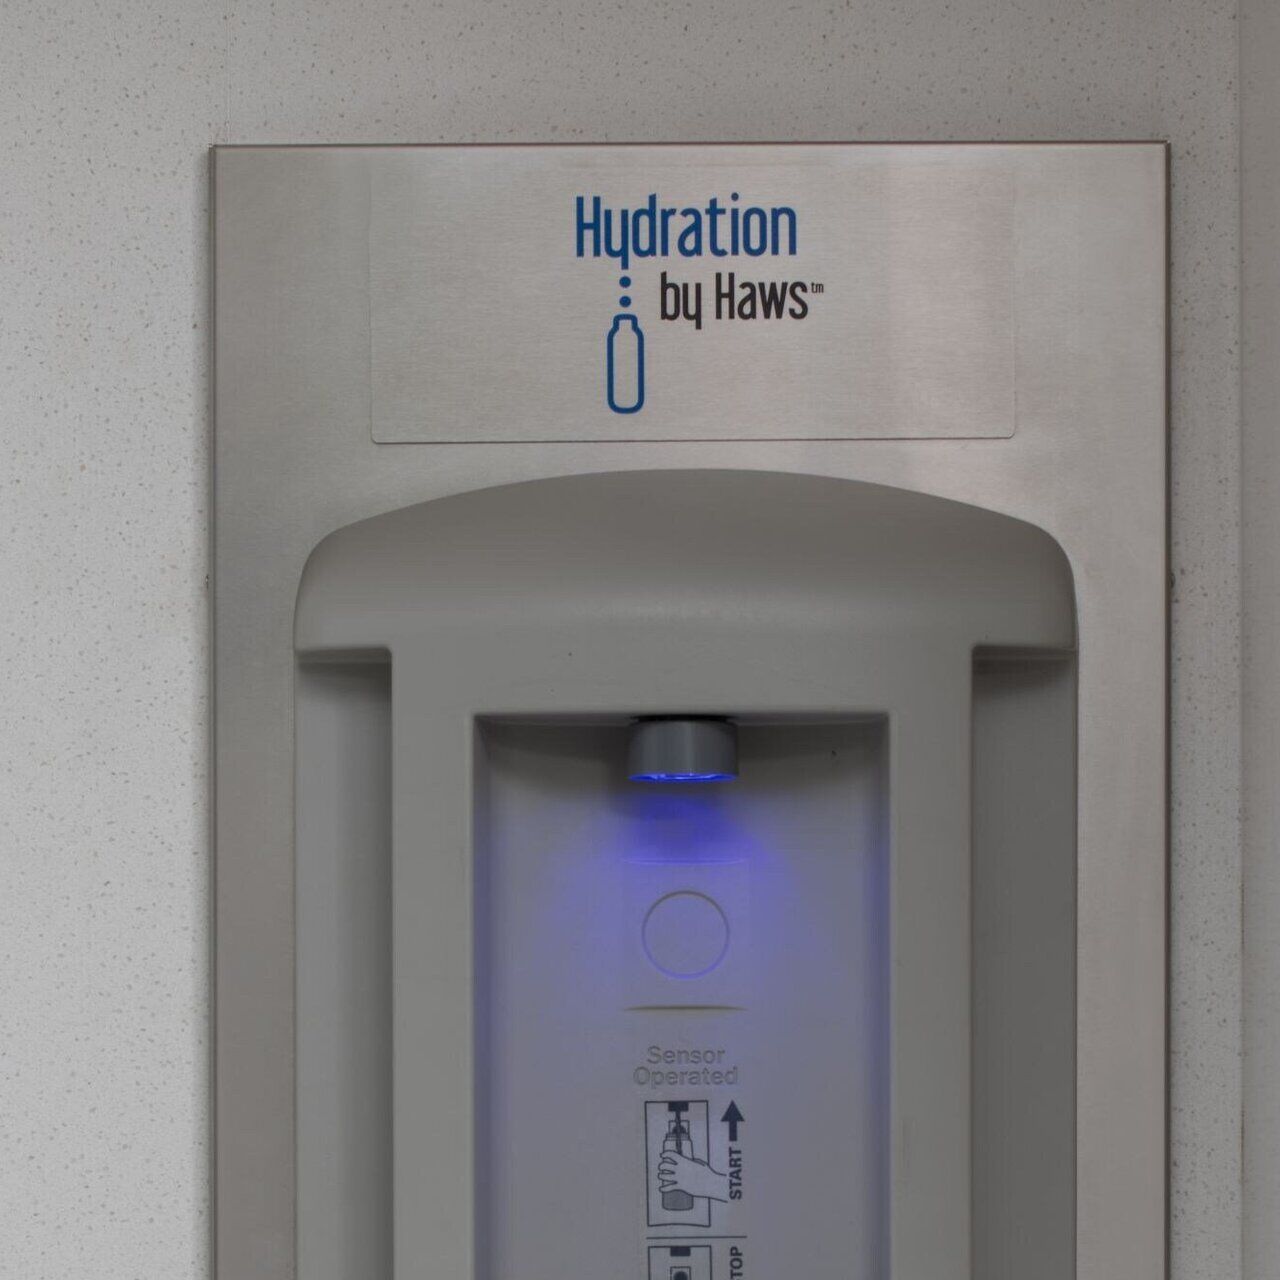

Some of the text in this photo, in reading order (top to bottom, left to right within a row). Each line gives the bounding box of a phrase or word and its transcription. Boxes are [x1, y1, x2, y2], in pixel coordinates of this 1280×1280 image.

[575, 192, 798, 270] Hydration
[660, 271, 702, 330] by
[632, 1066, 739, 1090] Operated
[646, 1045, 726, 1064] Sensor
[728, 1147, 743, 1201] START
